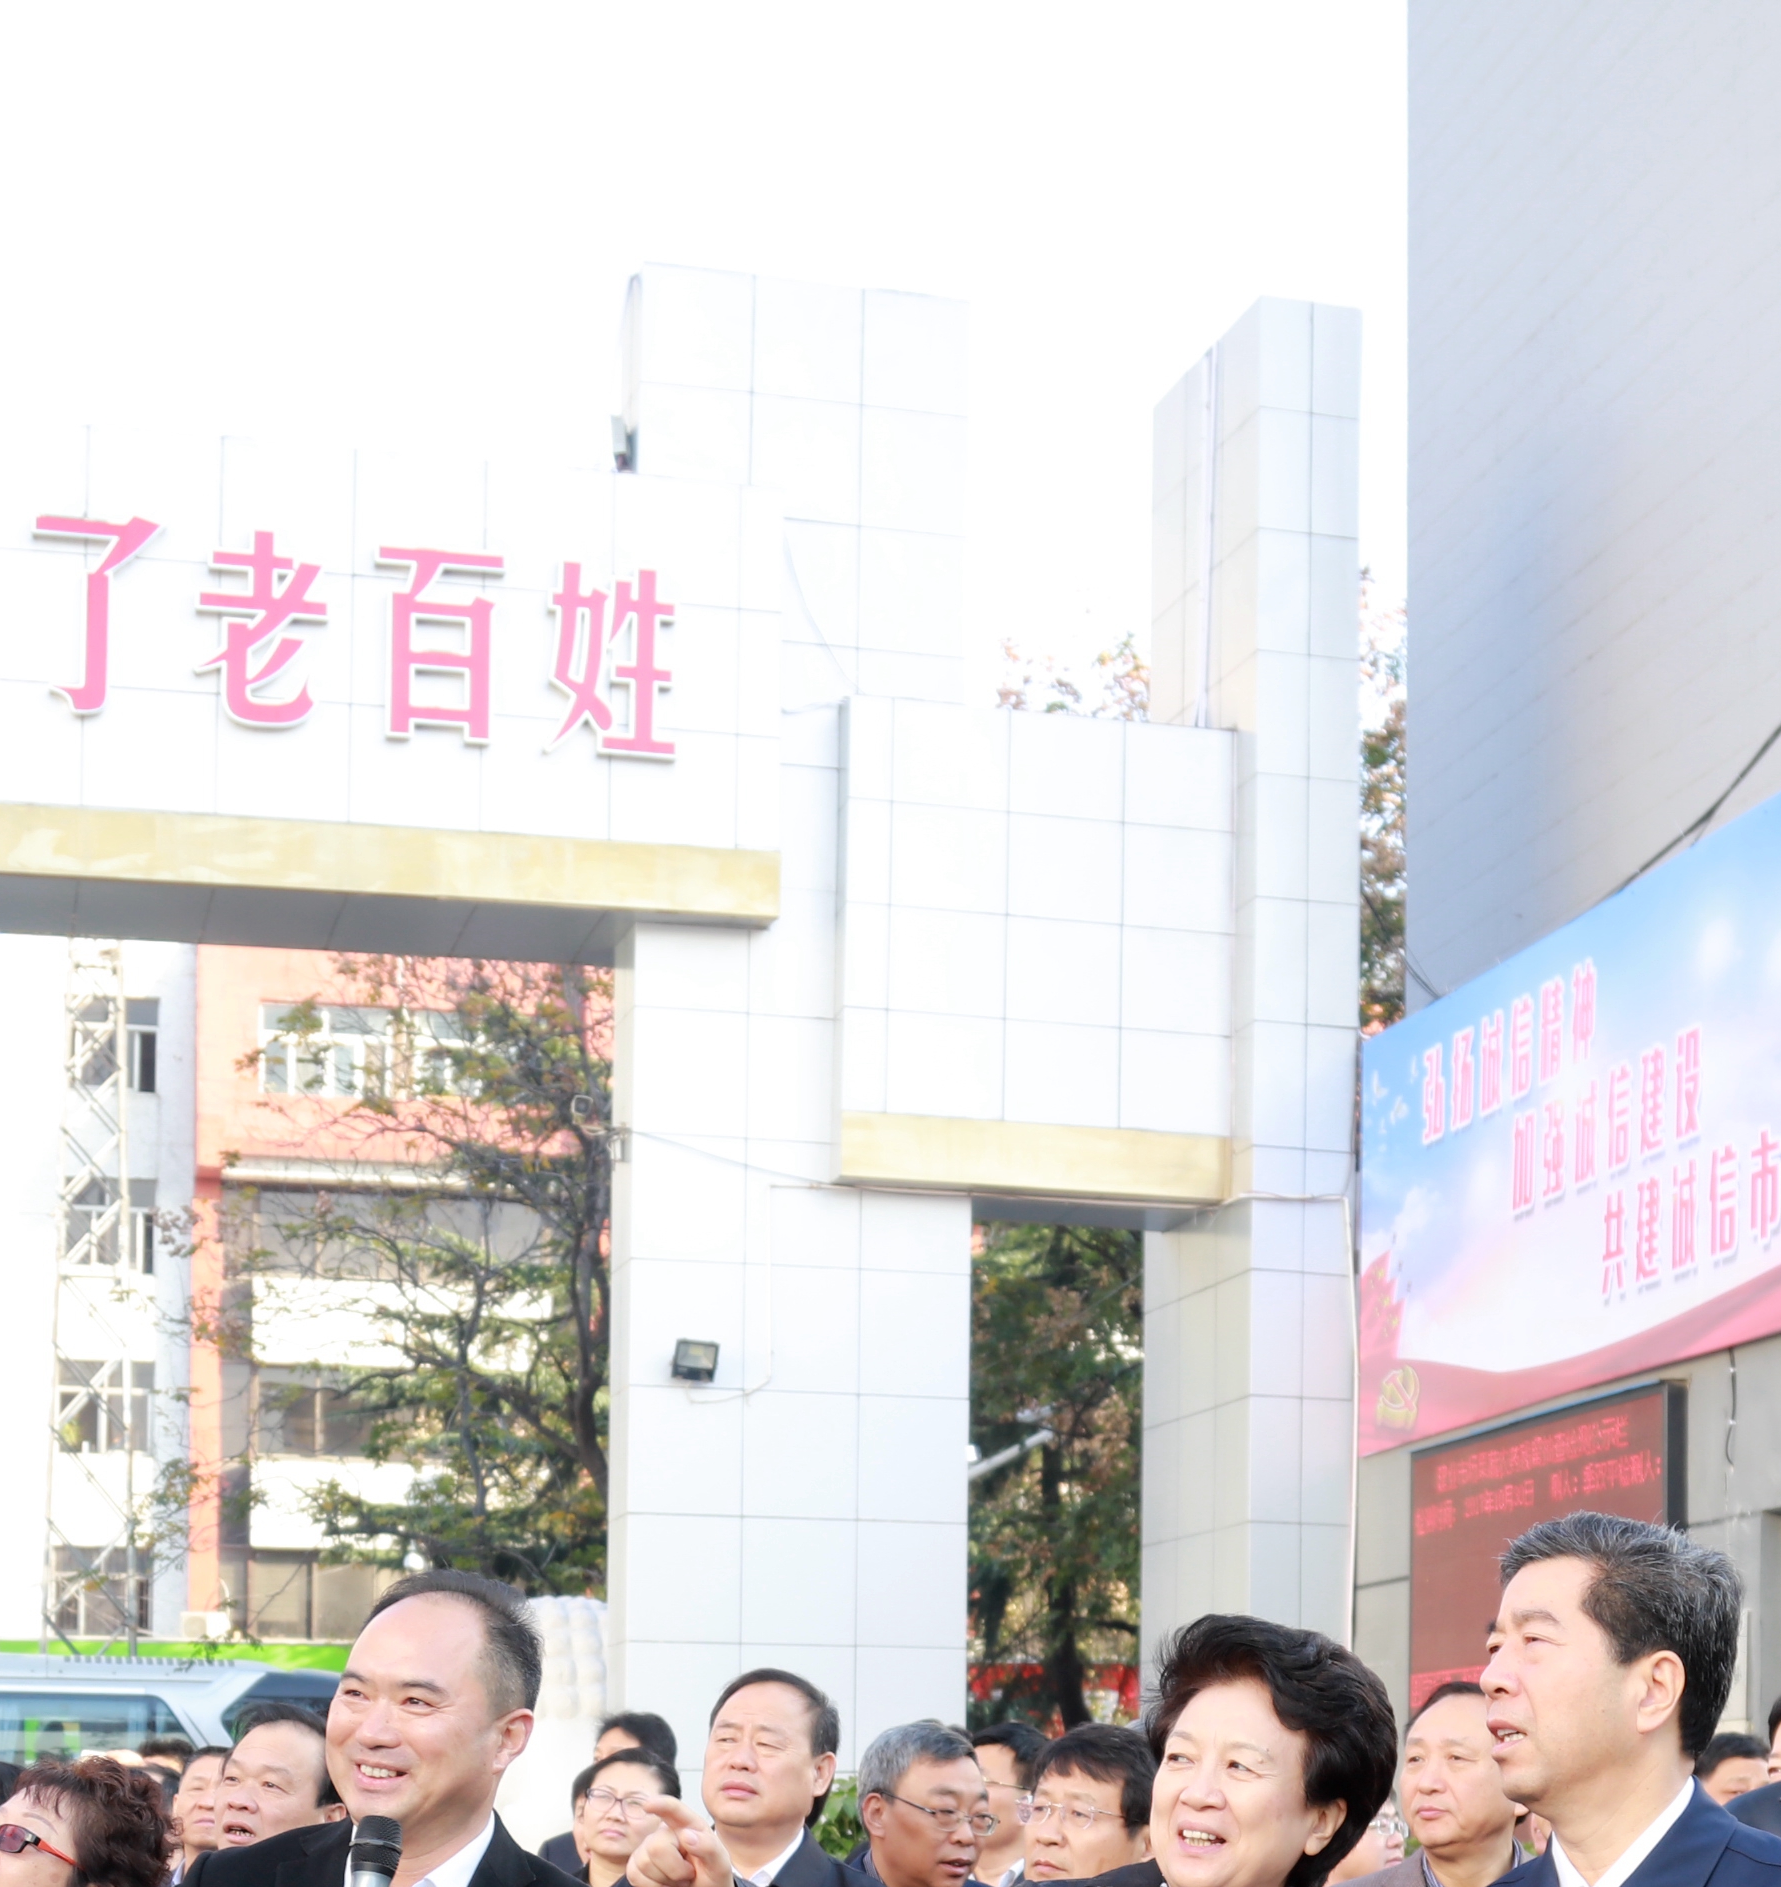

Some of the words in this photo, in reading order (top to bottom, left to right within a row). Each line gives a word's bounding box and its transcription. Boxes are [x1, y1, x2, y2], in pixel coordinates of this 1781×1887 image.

[1424, 959, 1597, 1143] 弘扬诚信精神
[1513, 1026, 1702, 1213] 加强诚信建设
